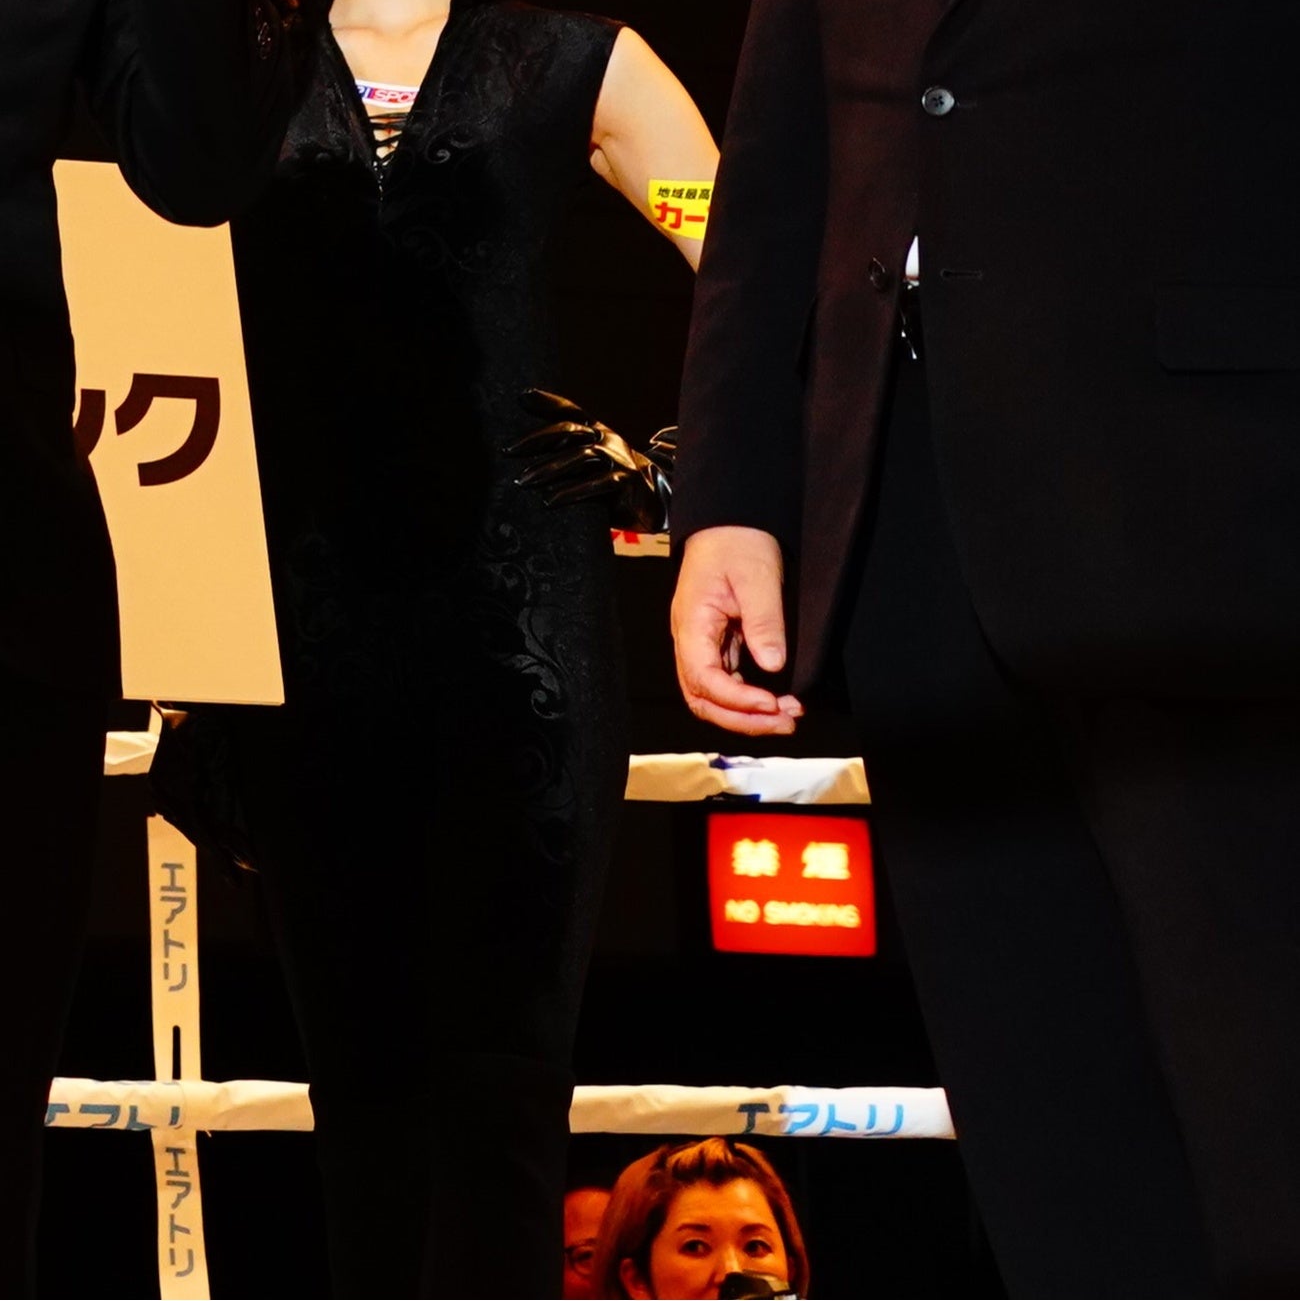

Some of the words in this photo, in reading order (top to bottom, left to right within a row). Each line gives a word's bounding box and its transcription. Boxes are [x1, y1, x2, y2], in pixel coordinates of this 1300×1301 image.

[655, 202, 709, 229] カー
[160, 862, 188, 992] エアトリ
[165, 1146, 194, 1278] エアトリ
